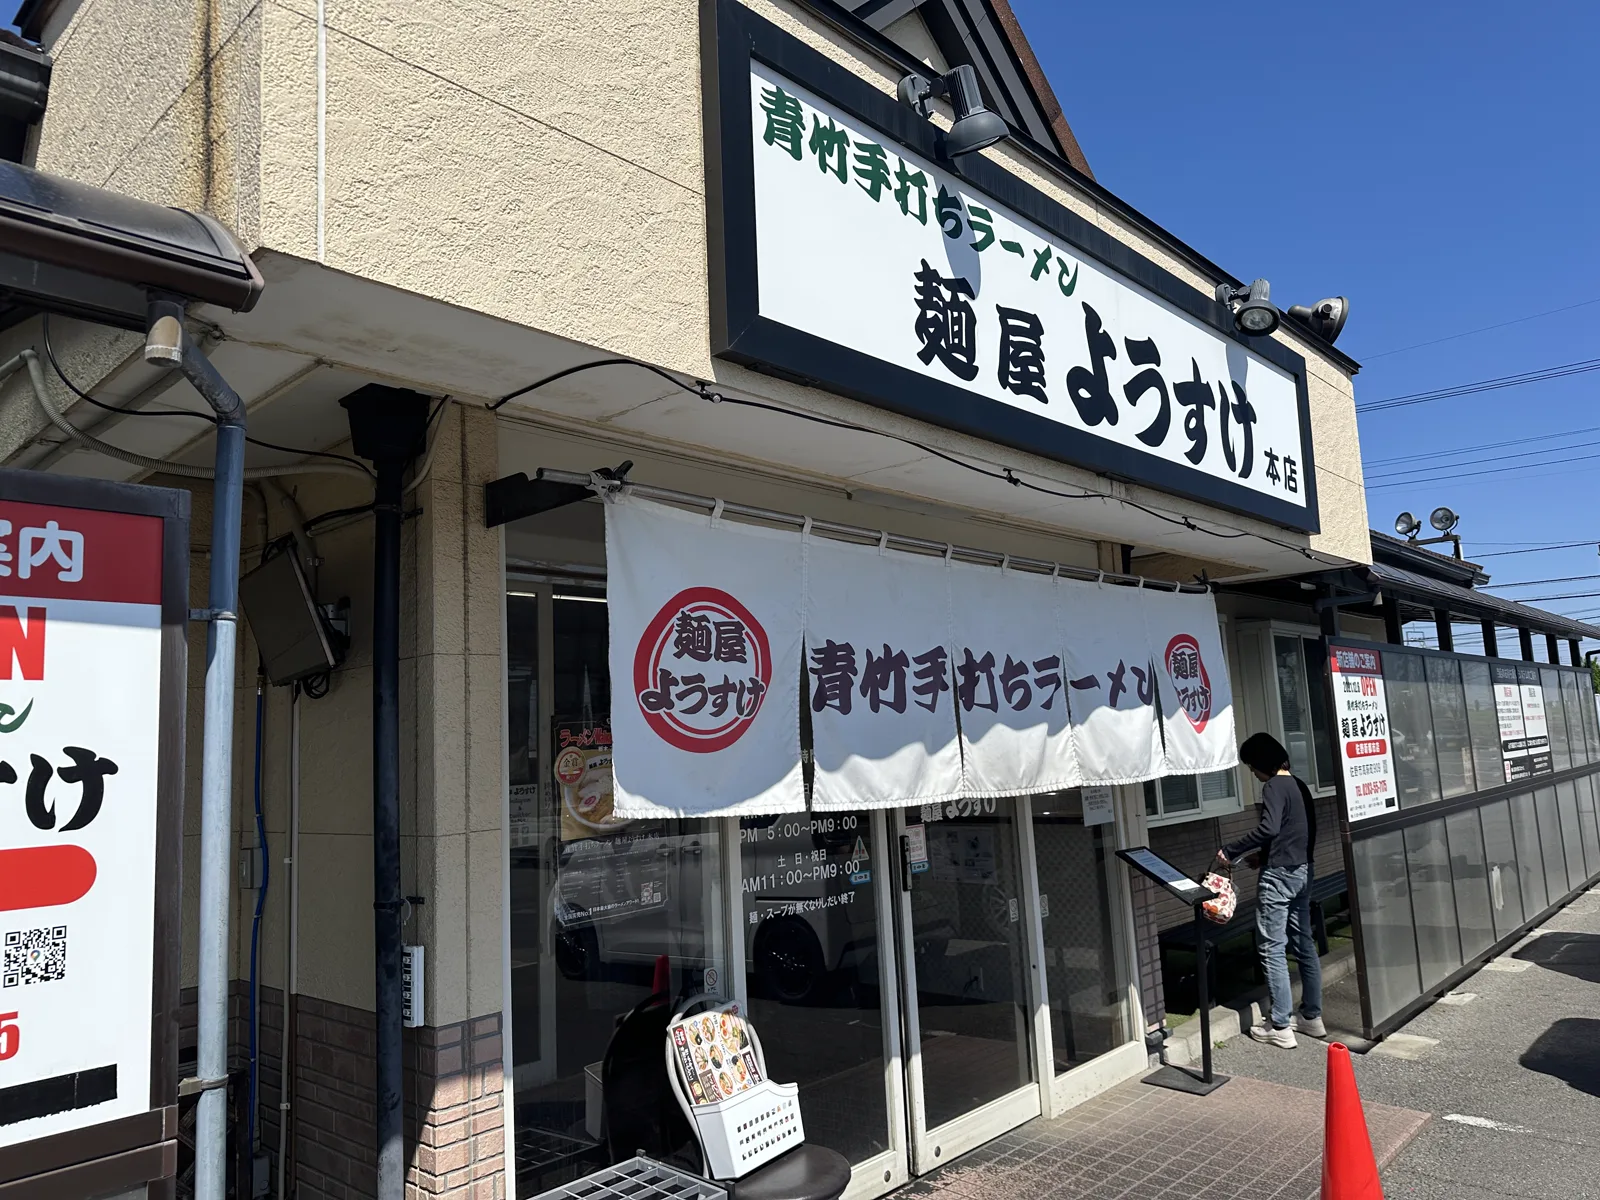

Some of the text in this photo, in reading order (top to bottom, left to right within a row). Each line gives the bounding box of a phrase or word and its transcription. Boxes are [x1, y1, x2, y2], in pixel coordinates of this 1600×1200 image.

[759, 86, 1079, 297] 青竹手打ちラーメン
[1263, 446, 1298, 494] 本店
[672, 610, 748, 664] 麺屋
[1171, 650, 1198, 680] 麺屋
[1360, 676, 1378, 697] OPEN
[640, 668, 766, 718] ようすけ
[0, 745, 119, 833] け
[740, 829, 758, 844] PM
